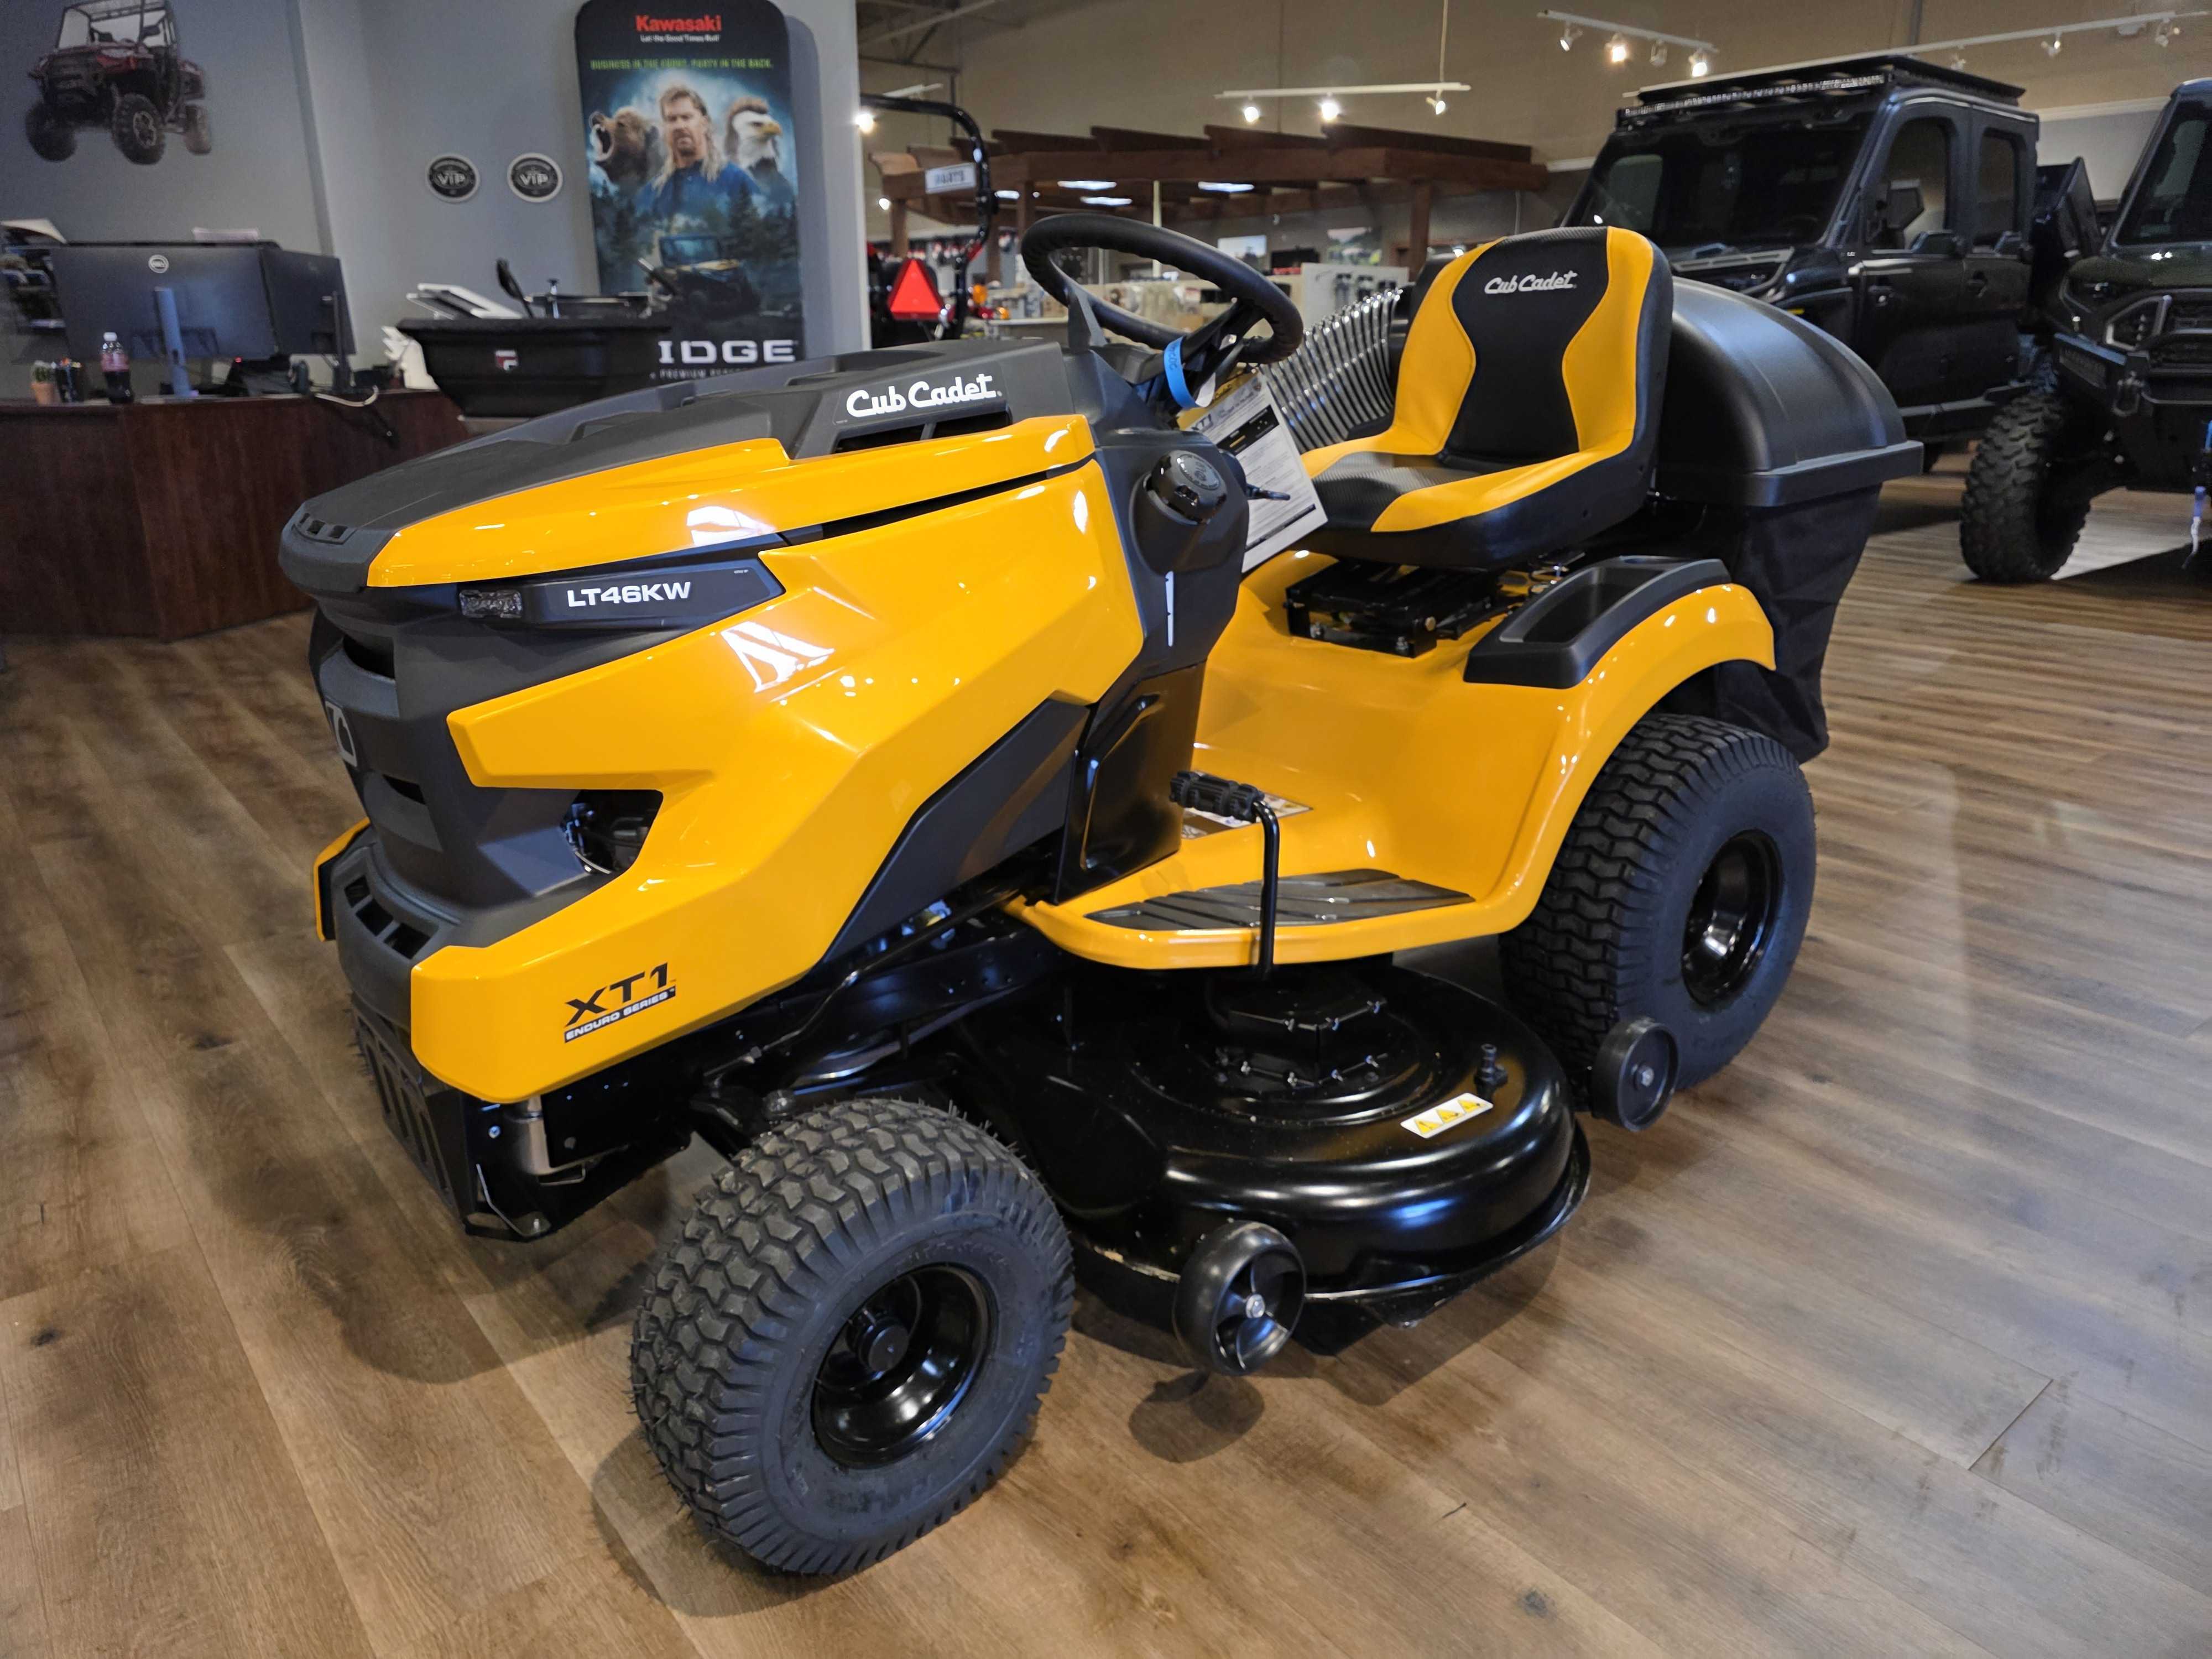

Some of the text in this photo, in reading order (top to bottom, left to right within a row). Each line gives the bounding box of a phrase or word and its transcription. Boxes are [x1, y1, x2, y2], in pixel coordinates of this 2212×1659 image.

[636, 15, 722, 31] Kawasaki
[590, 59, 630, 70] BUSINESS
[643, 59, 658, 69] THE
[719, 58, 729, 67] IN
[731, 58, 745, 68] THE
[437, 173, 466, 185] VIP
[519, 173, 549, 185] VIP
[1484, 270, 1578, 294] Cub Cadet
[658, 340, 795, 363] IDGE
[846, 373, 997, 418] Cub Cadet
[567, 581, 692, 608] LT46KW
[564, 962, 668, 1028] XT1
[565, 991, 669, 1041] ENDURO SERIES
